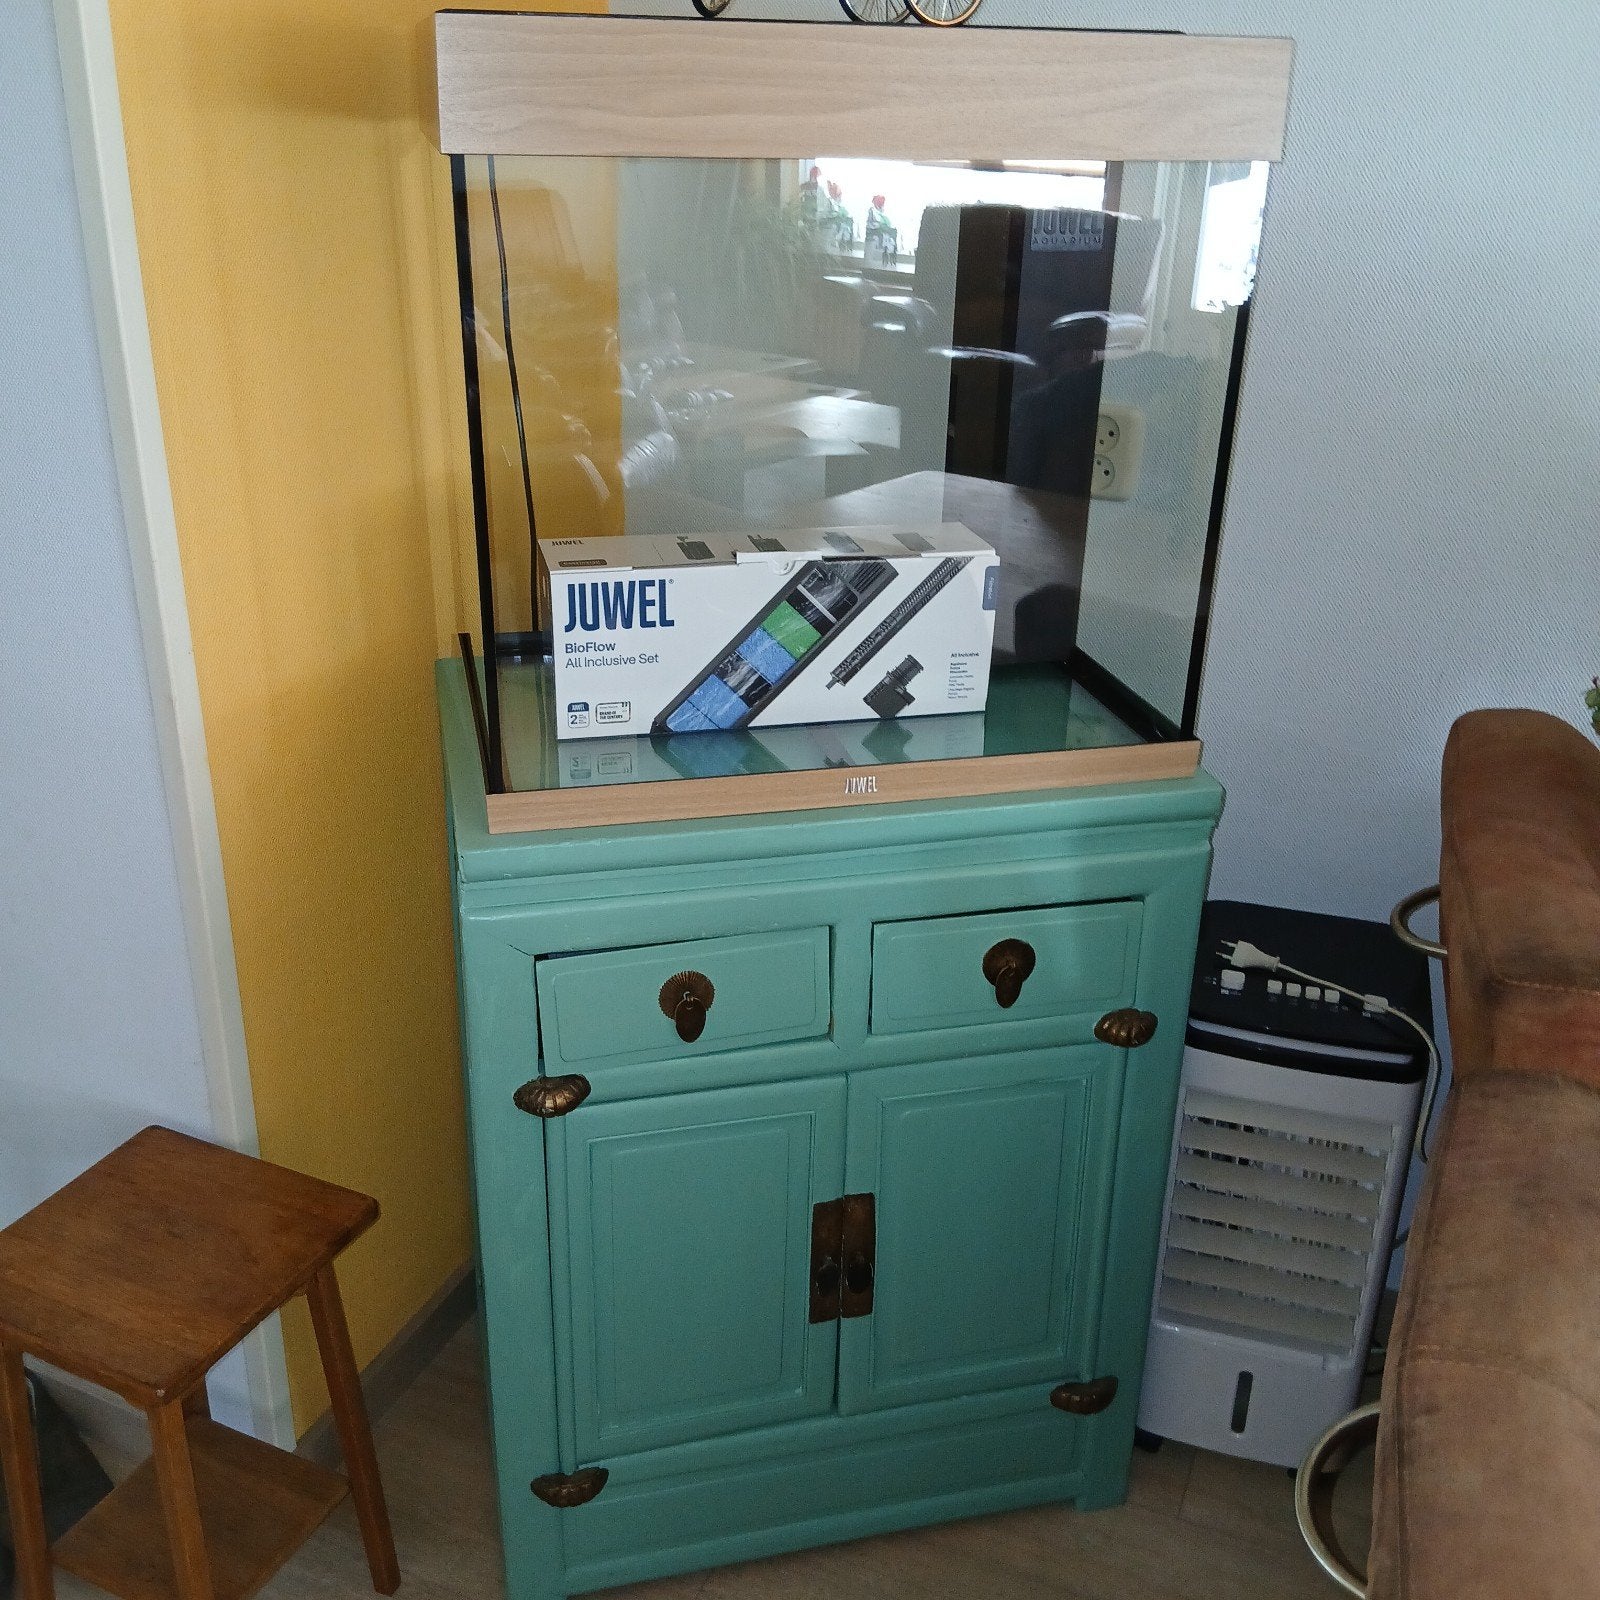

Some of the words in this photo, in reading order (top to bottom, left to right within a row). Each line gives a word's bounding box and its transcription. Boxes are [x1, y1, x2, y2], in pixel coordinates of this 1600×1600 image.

[1033, 236, 1101, 245] AQUARIUM
[565, 642, 616, 654] BioFlow
[565, 657, 583, 669] All
[584, 655, 636, 668] Inclusive
[638, 653, 659, 665] Set
[570, 714, 578, 725] 2
[845, 775, 878, 794] JUWEL
